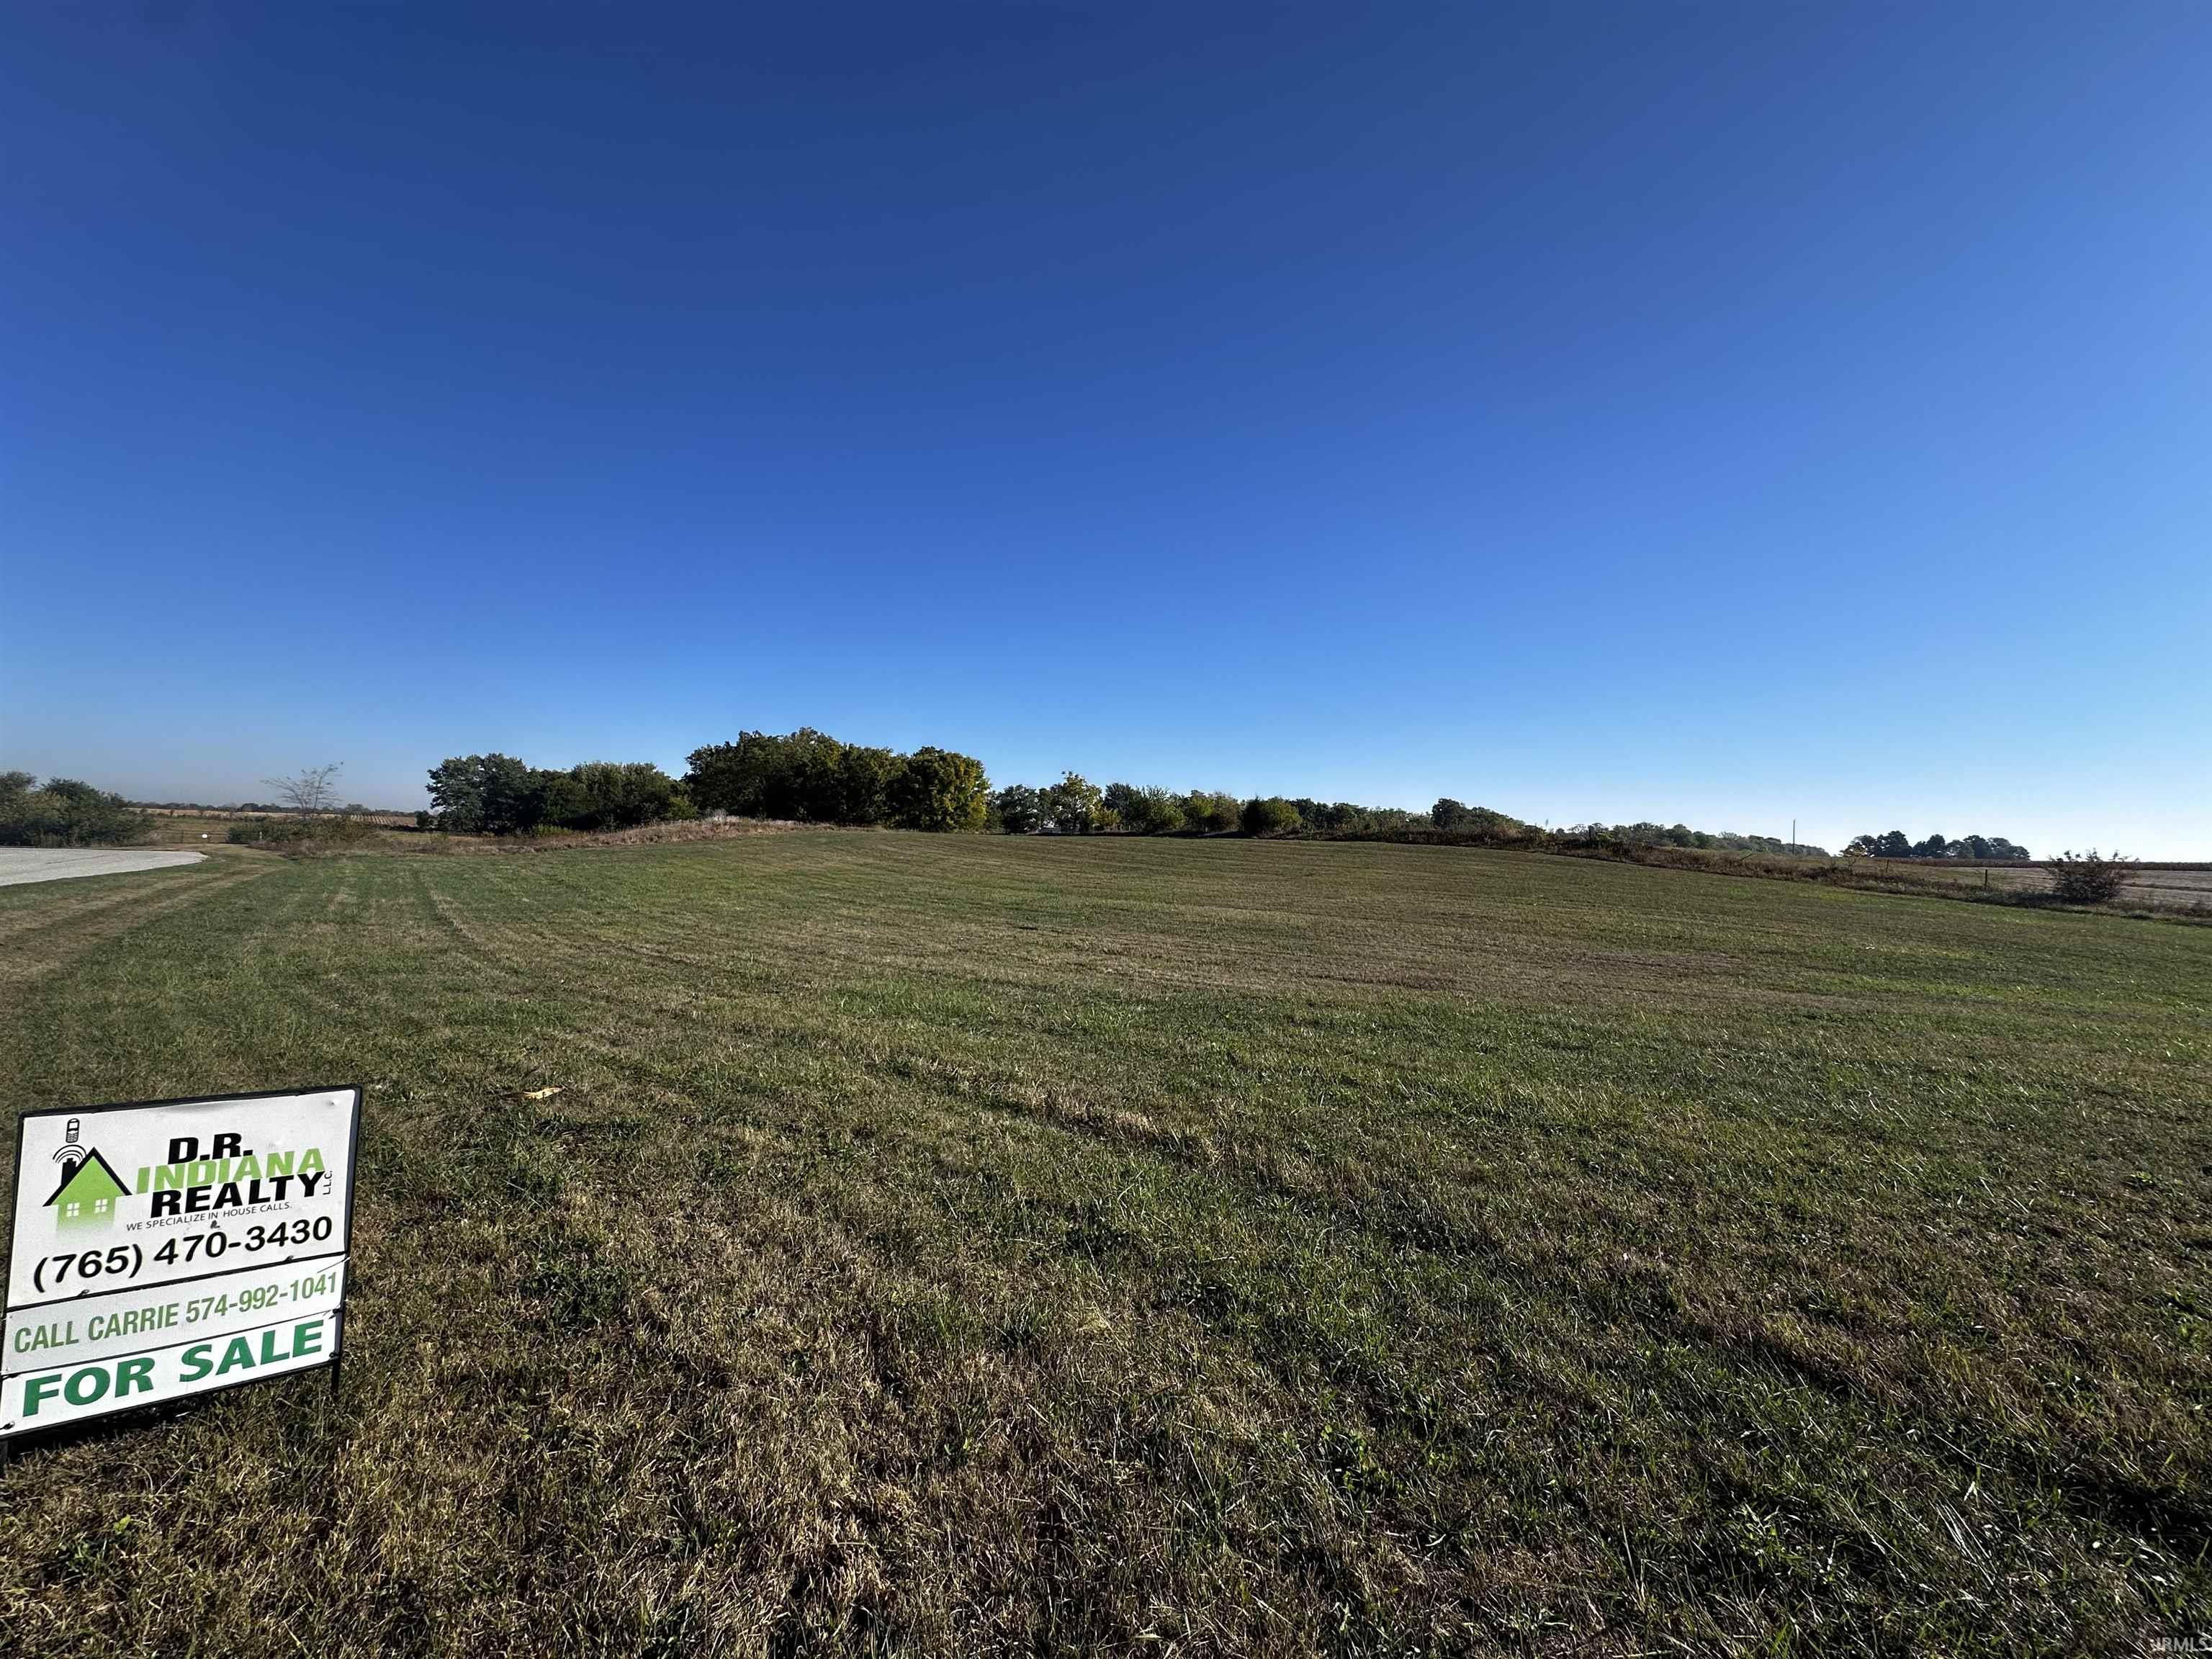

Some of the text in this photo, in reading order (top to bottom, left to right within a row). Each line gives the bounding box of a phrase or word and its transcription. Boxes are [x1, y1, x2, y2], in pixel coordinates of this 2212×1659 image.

[136, 1148, 325, 1195] INDIANA
[168, 1132, 253, 1165] D.R.
[150, 1170, 325, 1218] REALTY
[126, 1223, 143, 1231] WE
[145, 1214, 206, 1228] SPECIALIZE
[223, 1207, 257, 1217] HOUSE
[34, 1216, 333, 1292] (765) 470-3430
[14, 1272, 337, 1353] CALL CARRIE 574-992-1041
[22, 1320, 325, 1417] FOR SALE
